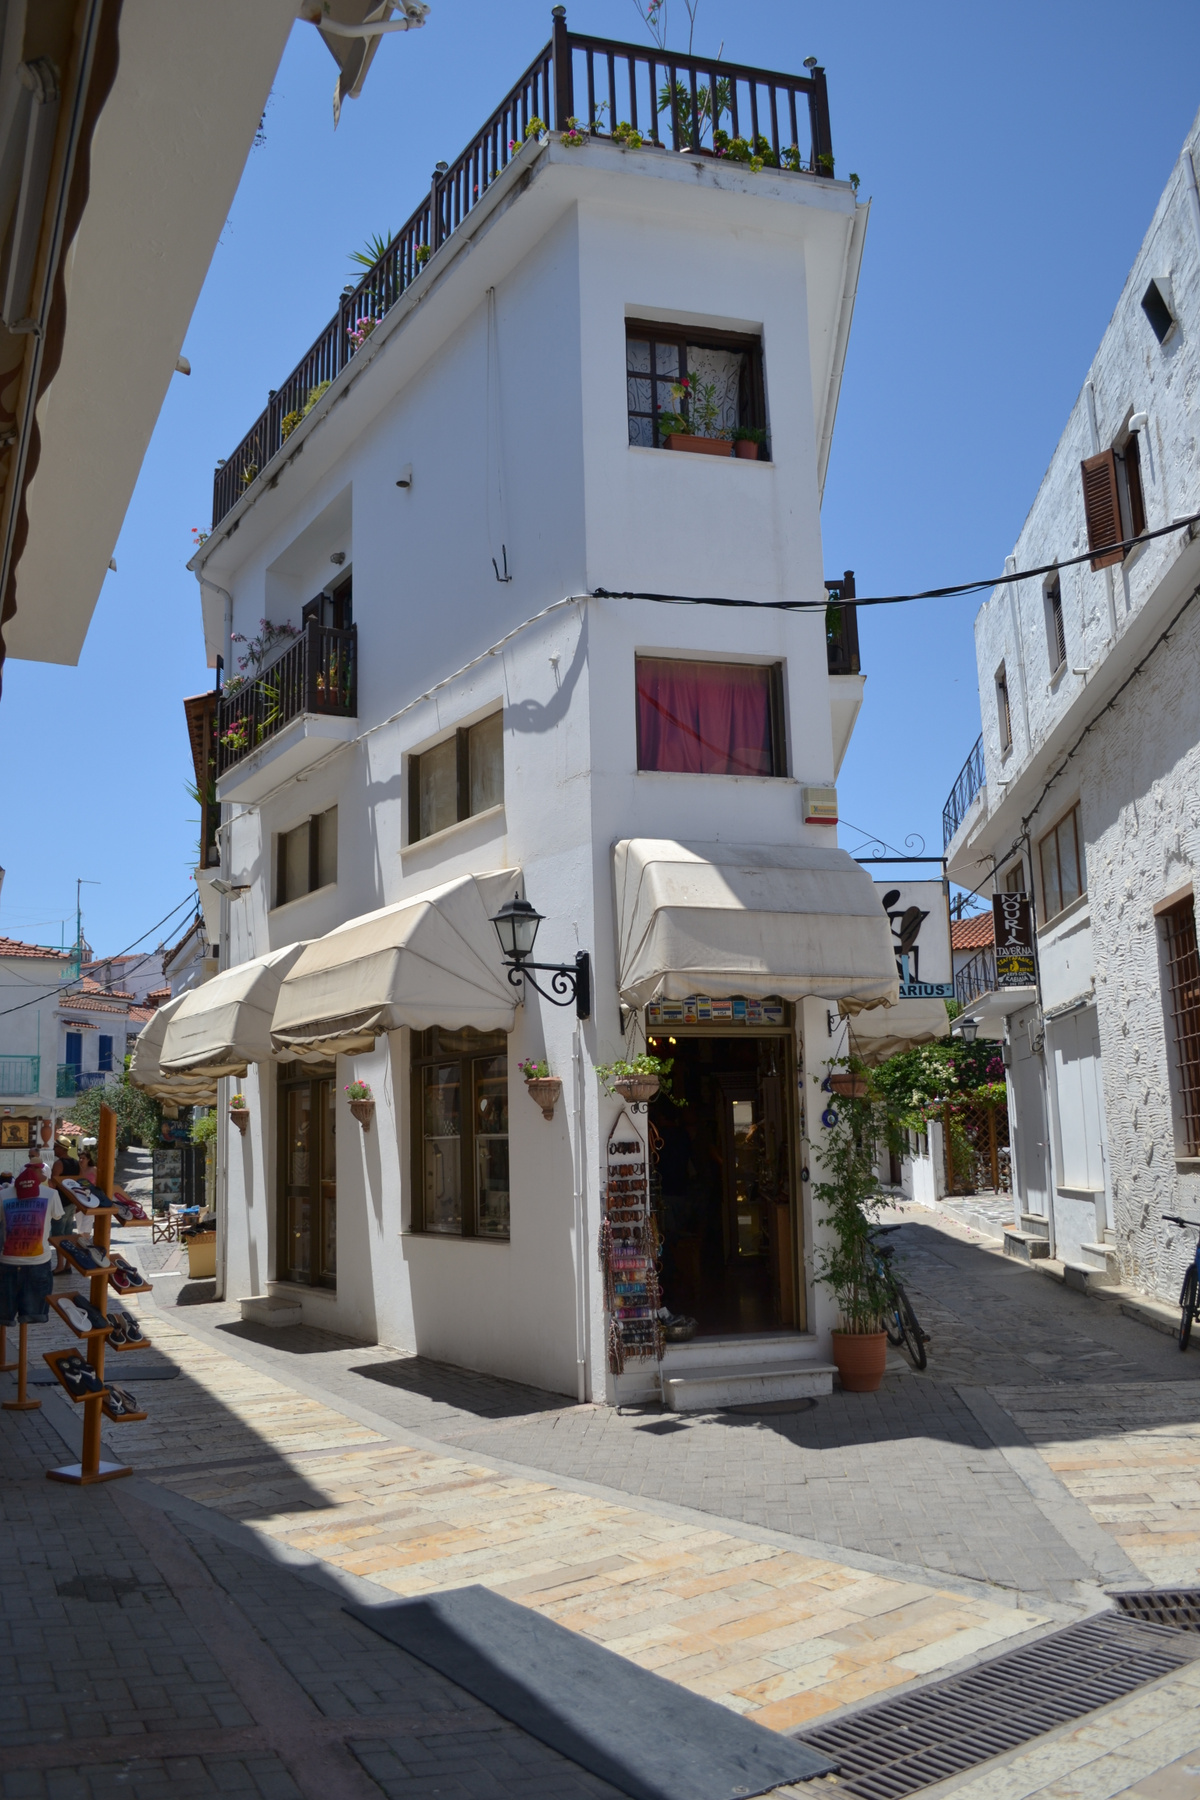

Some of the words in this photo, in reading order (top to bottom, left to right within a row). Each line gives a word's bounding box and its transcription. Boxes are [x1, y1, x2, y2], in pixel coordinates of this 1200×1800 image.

[1001, 893, 1024, 946] MOURIA
[996, 945, 1033, 956] TAVERNA
[5, 1199, 45, 1209] MANHATTAN
[12, 1213, 36, 1223] BEACH
[13, 1241, 30, 1250] CITY
